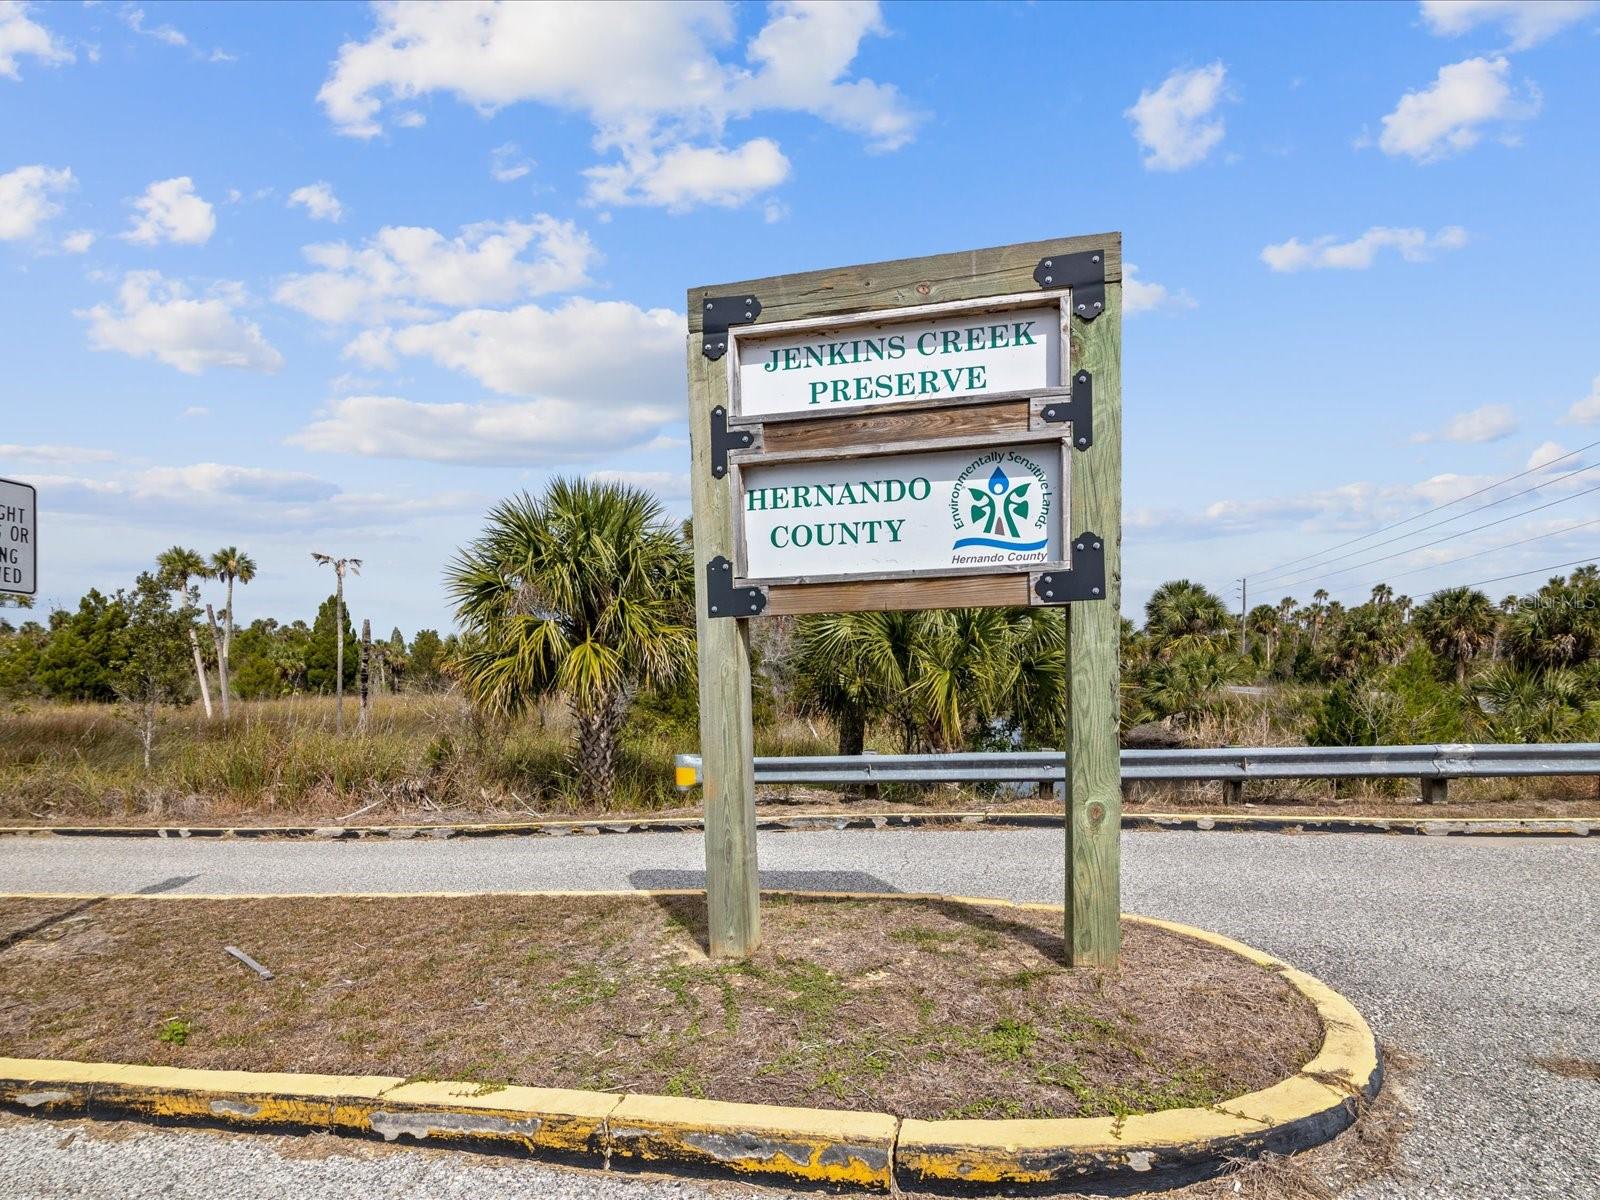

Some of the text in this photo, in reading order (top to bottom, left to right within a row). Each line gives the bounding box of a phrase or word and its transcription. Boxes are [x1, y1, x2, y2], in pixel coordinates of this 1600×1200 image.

[764, 321, 1037, 373] JENKINS CREEK
[808, 365, 988, 405] PRESERVE
[746, 477, 932, 511] HERNANDO
[949, 451, 1053, 530] Environmentally Sensitive Lands
[10, 525, 28, 543] OR
[770, 519, 906, 548] COUNTY
[951, 552, 1048, 564] Hernando County
